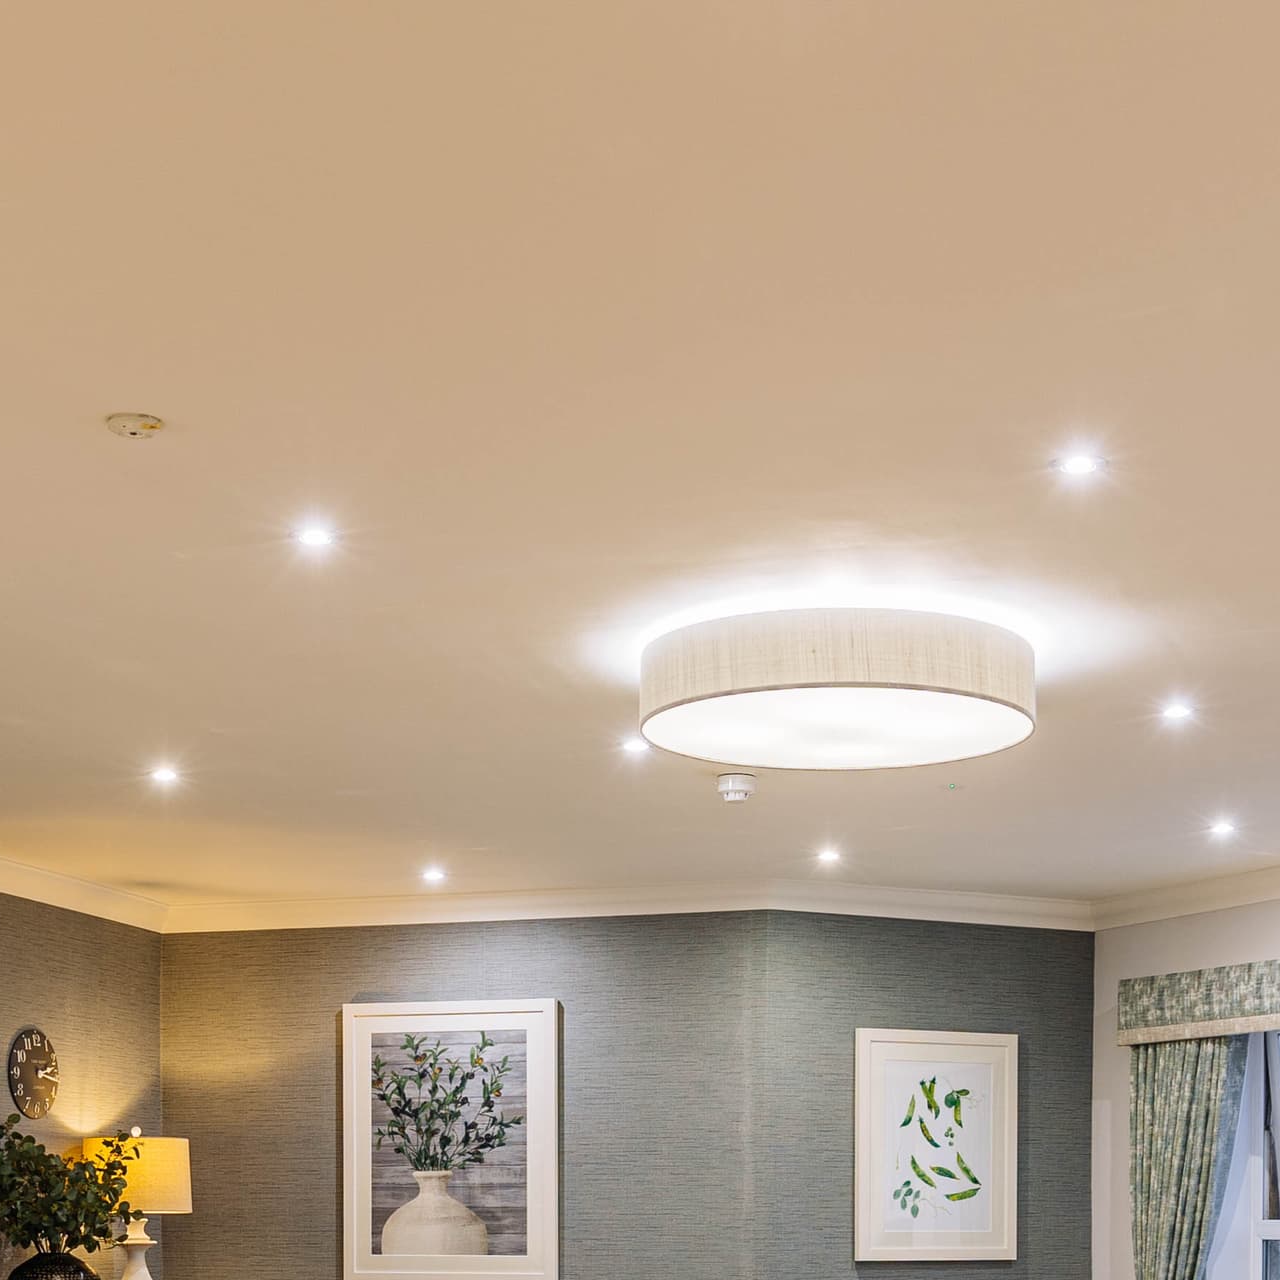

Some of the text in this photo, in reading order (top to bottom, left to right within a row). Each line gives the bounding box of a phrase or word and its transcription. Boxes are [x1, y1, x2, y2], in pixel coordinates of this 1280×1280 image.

[24, 1037, 32, 1050] 11
[32, 1033, 41, 1046] 12
[44, 1040, 49, 1052] 1
[17, 1050, 26, 1063] 10
[13, 1065, 20, 1079] 9
[17, 1083, 24, 1096] 8
[24, 1096, 32, 1109] 7
[34, 1101, 41, 1113] 6
